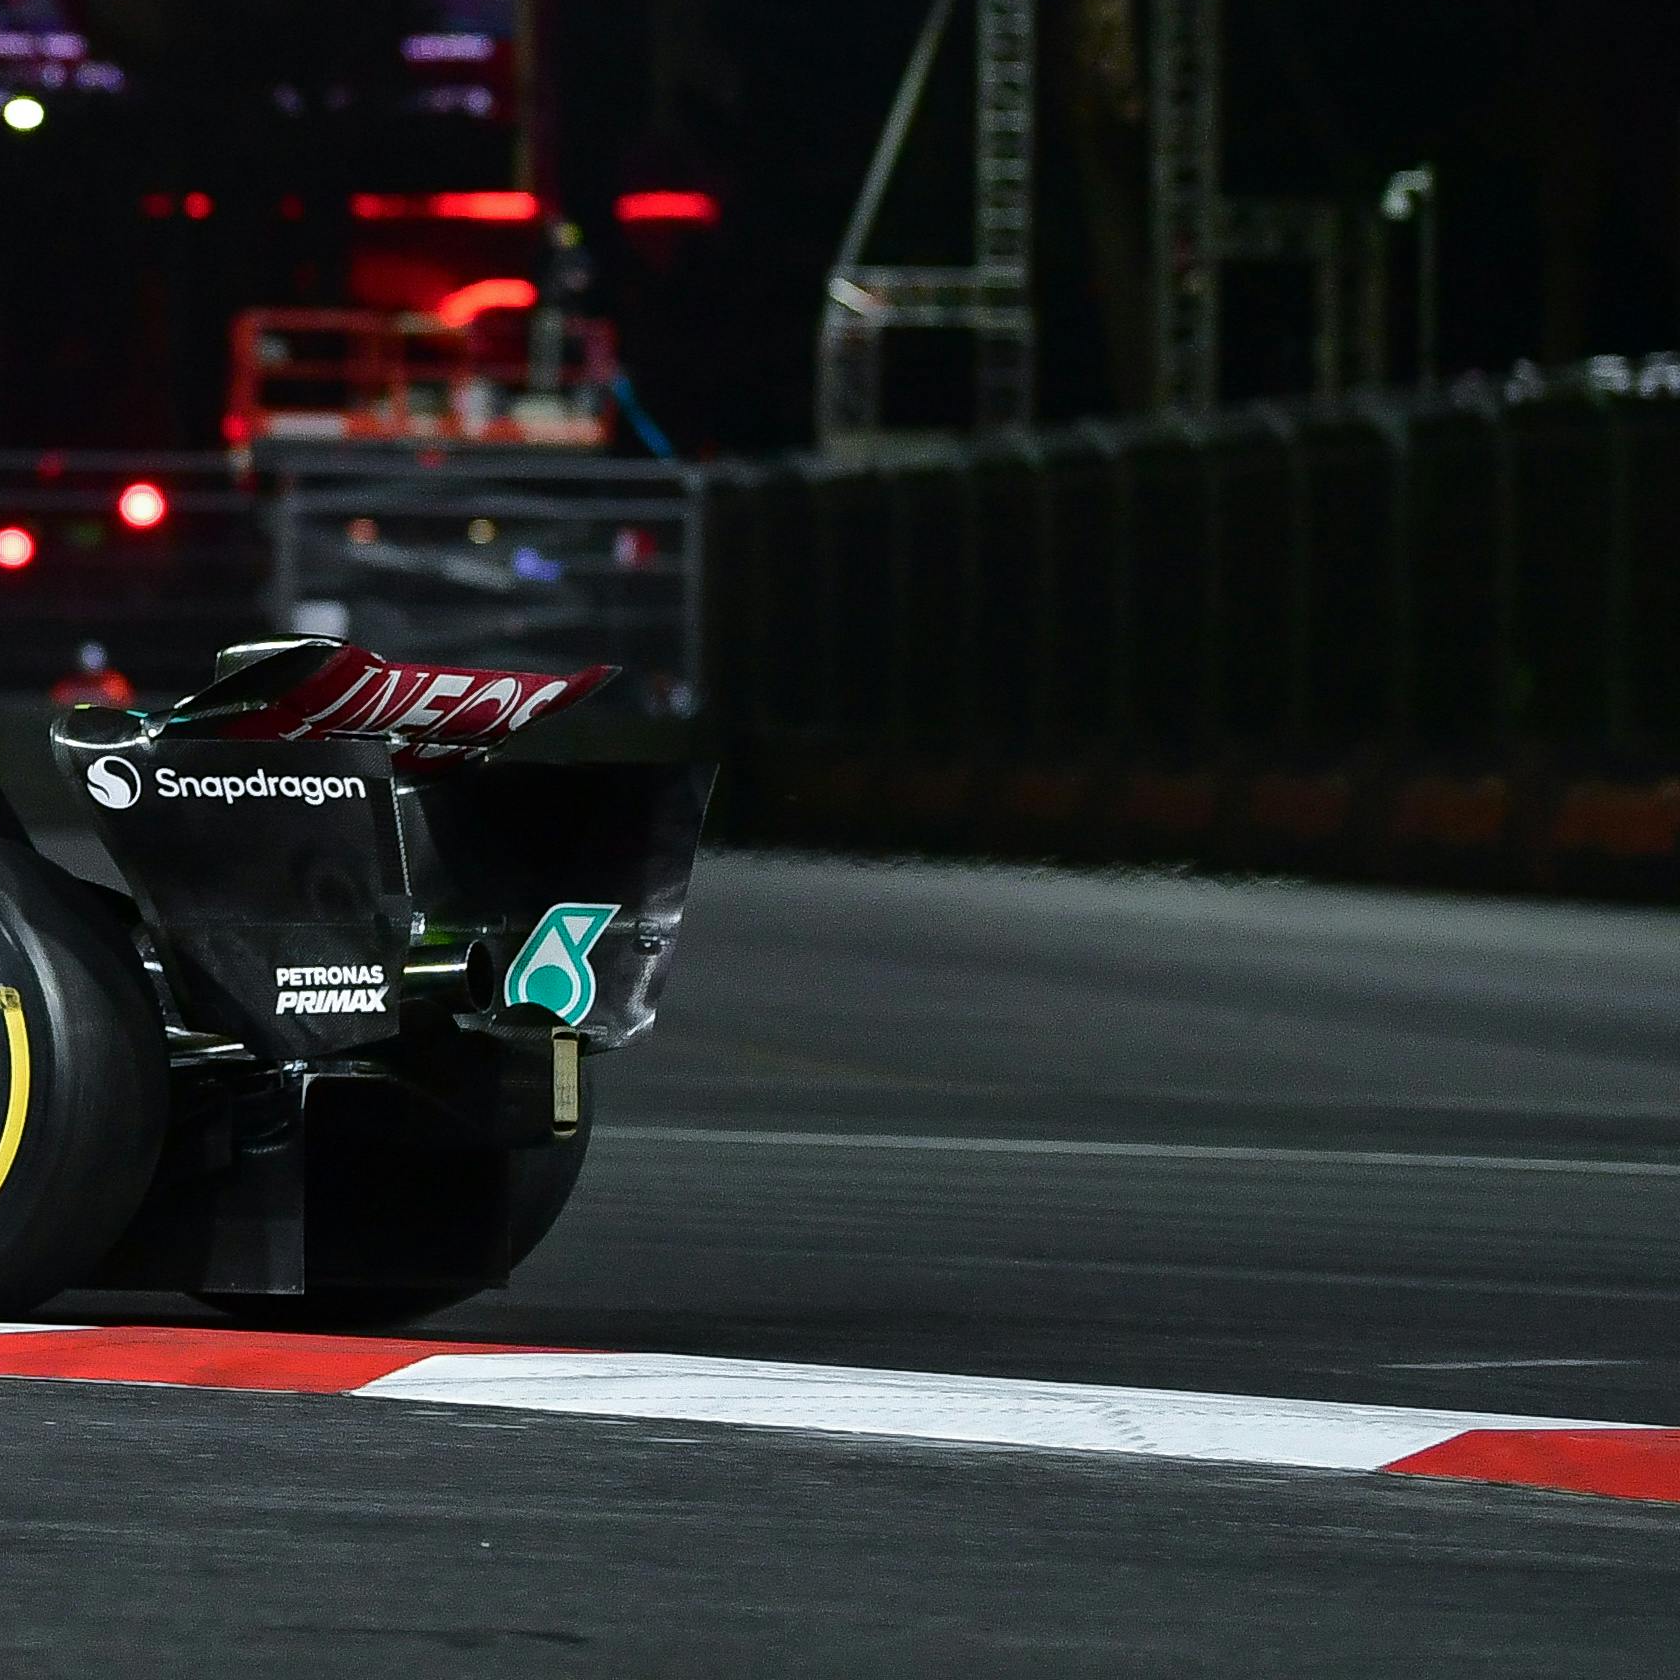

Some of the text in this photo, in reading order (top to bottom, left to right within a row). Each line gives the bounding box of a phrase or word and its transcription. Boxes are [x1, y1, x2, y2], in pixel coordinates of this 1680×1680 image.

[156, 767, 366, 806] Snapdragon
[275, 966, 384, 986] PETRONAS
[275, 988, 388, 1015] PRIMAX
